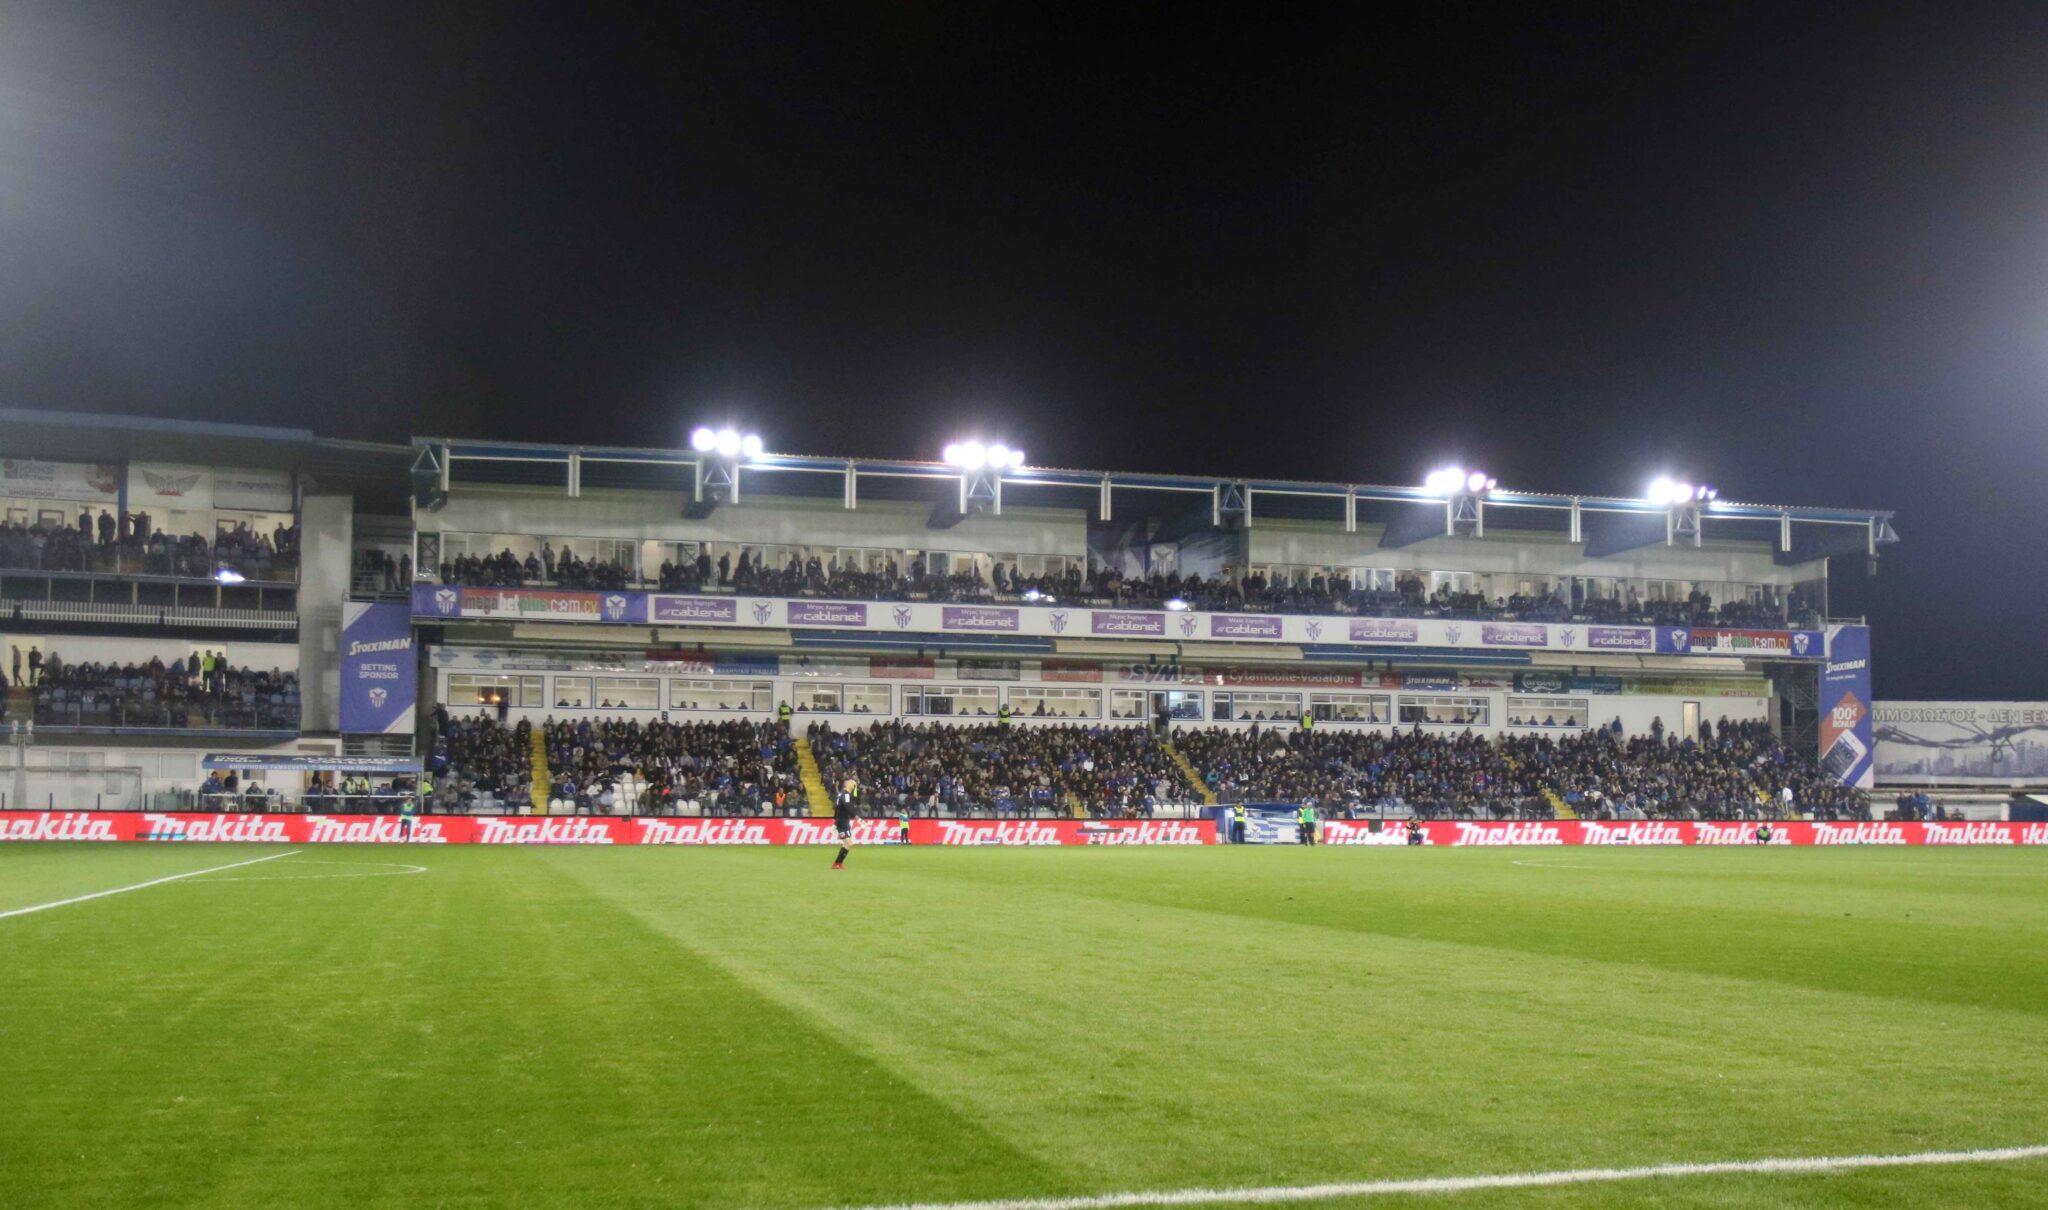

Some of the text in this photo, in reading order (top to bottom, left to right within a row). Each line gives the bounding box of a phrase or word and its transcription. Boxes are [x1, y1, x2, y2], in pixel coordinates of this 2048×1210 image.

[671, 606, 732, 618] cablenet
[804, 611, 863, 622] cablenet
[958, 616, 1014, 627] cablenet
[1107, 620, 1160, 632] cablenet
[1225, 624, 1278, 635] cablenet
[1363, 629, 1413, 640] cablenet
[1601, 636, 1648, 646] cablenet
[361, 664, 398, 672] BETTING
[360, 671, 399, 679] SPONSOR
[1872, 708, 1976, 722] ΜΜΟΧΩΣΤΟΣ
